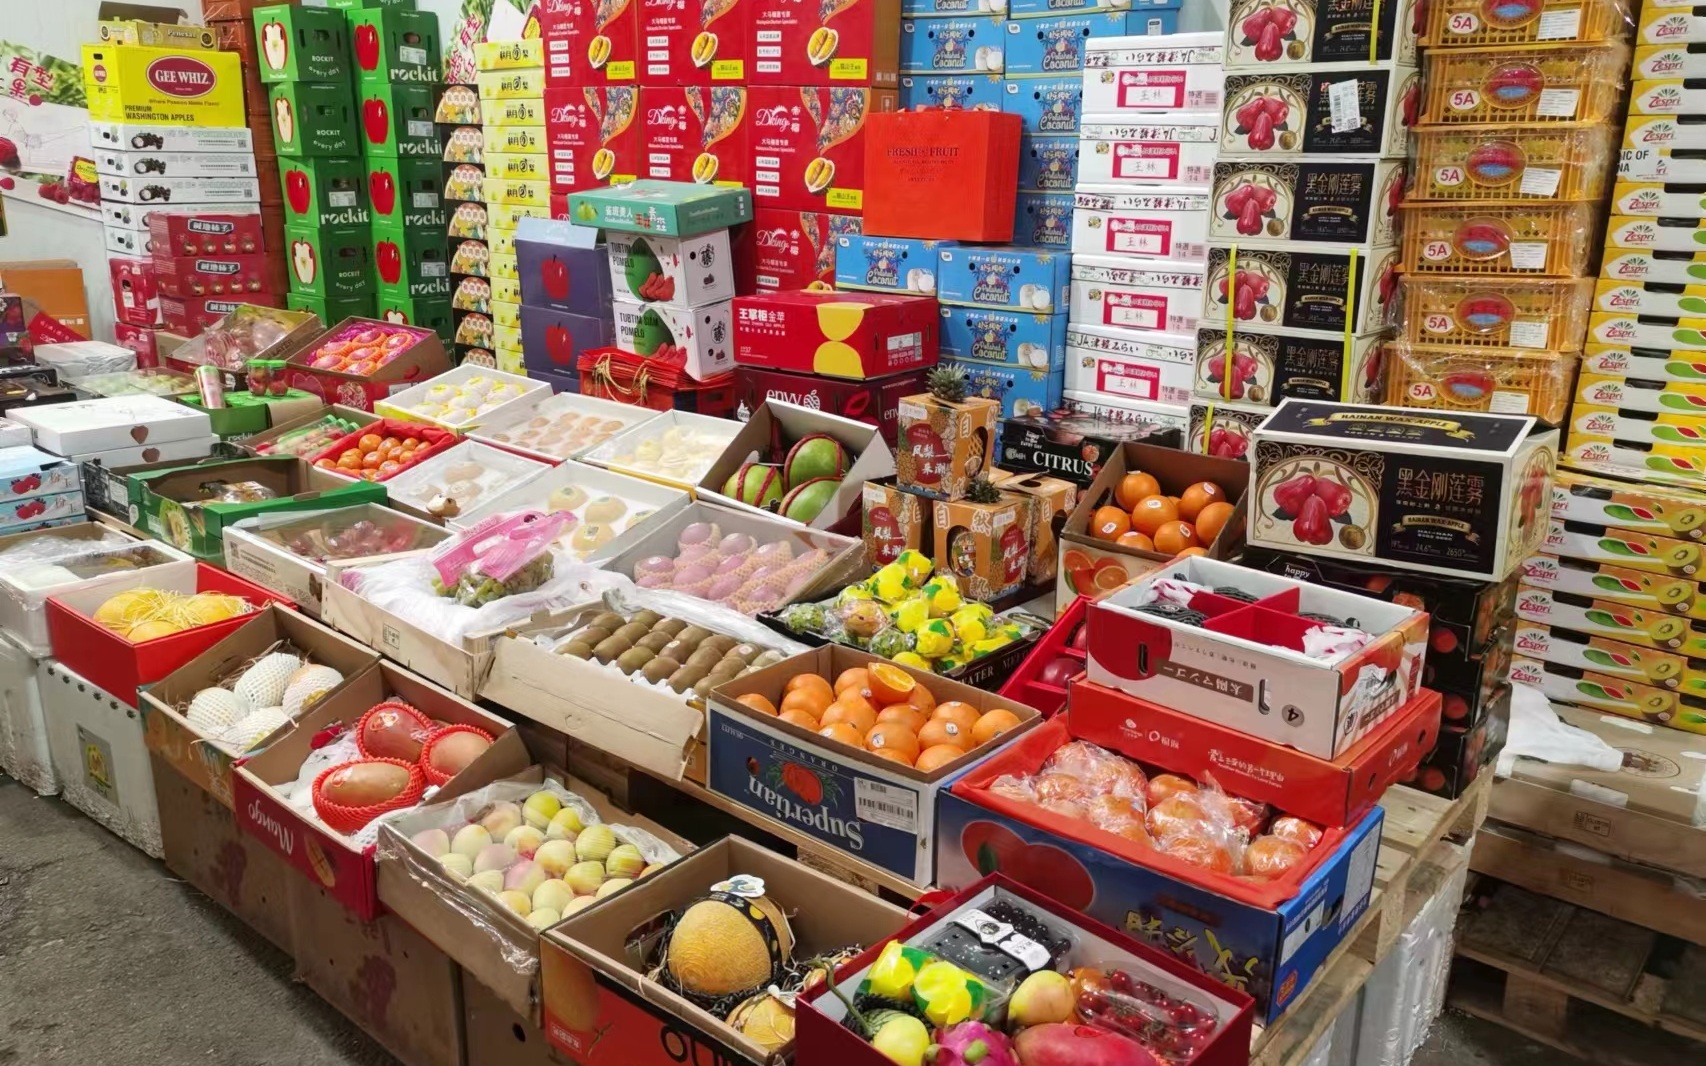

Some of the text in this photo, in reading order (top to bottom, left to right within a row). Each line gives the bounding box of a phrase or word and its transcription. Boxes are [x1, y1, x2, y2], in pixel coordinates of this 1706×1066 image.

[1452, 16, 1472, 30] 5A
[1656, 24, 1688, 37] Zespri
[933, 55, 966, 68] Coconut
[1043, 55, 1080, 70] Coconut
[1651, 60, 1684, 72] Zespri
[155, 70, 209, 84] GEE WHIZ
[308, 66, 340, 78] every day
[390, 66, 439, 82] rockit
[1453, 93, 1474, 105] 5A
[1649, 96, 1681, 108] Zespri
[126, 112, 169, 121] WASHINGTON
[1039, 117, 1076, 131] Coconut
[1642, 130, 1674, 144] Zespri
[313, 140, 346, 150] every day
[888, 147, 960, 156] FRESH FRUIT
[1636, 150, 1649, 160] OF
[1037, 176, 1073, 188] Coconut
[1440, 169, 1460, 182] 5A
[1628, 199, 1660, 211] Zespri
[320, 208, 369, 225] rockit
[405, 211, 445, 226] rocki
[1033, 231, 1068, 244] Coconut
[1624, 231, 1655, 242] Zespri
[1427, 244, 1447, 257] 5A
[612, 256, 635, 268] POMELO
[1618, 261, 1649, 274] Zespri
[336, 280, 366, 291] every day
[866, 272, 898, 286] Coconut
[411, 278, 450, 294] rocki
[973, 288, 1010, 303] Coconut
[1610, 294, 1641, 307] Zespri
[620, 312, 642, 324] TUBTIM
[1428, 316, 1448, 330] 5A
[620, 326, 645, 338] POMELO
[1605, 326, 1636, 339] Zespri
[972, 344, 1008, 359] Coconut
[1598, 357, 1628, 370] Zespri
[766, 389, 801, 405] envy
[1412, 384, 1433, 398] 5A
[1593, 389, 1624, 401] Zespri
[884, 408, 900, 420] env
[1341, 413, 1449, 428] HAINAN WAX APPLE
[1585, 419, 1615, 431] Zespri
[1580, 449, 1611, 461] Zespri
[1033, 450, 1094, 476] CITRUS
[1396, 468, 1484, 505] 黑金刚莲雾
[1447, 521, 1464, 529] APPLE
[1285, 565, 1310, 578] happy
[1525, 564, 1560, 580] Zespri
[1519, 600, 1552, 614] Zespri
[1517, 637, 1550, 652] Zespri
[1163, 666, 1243, 696] 太陽マンゴー
[1510, 669, 1542, 684] Zespri
[1287, 708, 1299, 722] 4
[769, 738, 838, 772] ORANGES
[749, 773, 864, 851] Supertian
[248, 800, 294, 855] Mango
